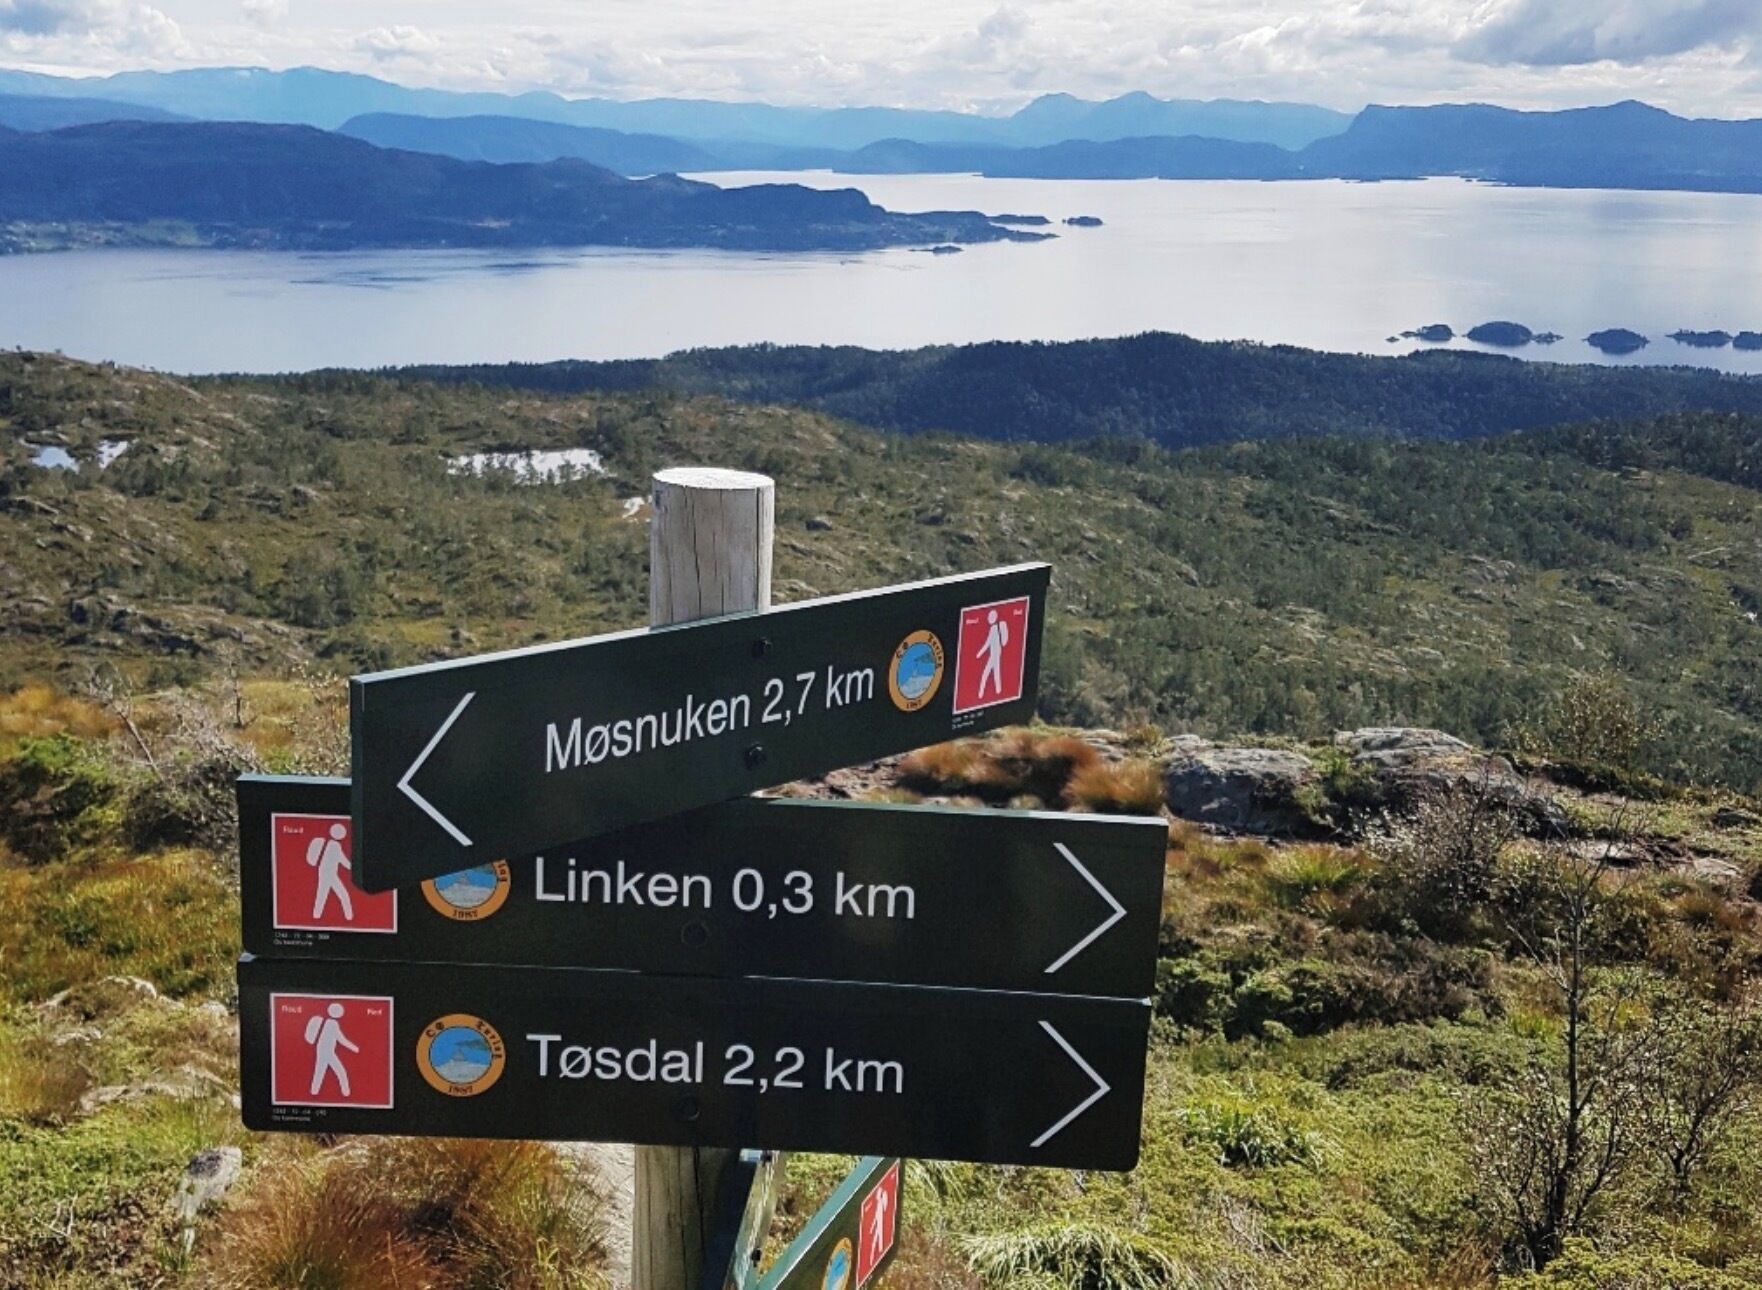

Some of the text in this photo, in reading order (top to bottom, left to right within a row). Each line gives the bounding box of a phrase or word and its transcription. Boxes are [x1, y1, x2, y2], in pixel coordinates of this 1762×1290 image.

[545, 665, 875, 772] Møsnuken 2,7 km
[535, 857, 915, 920] Linken 0,3 km
[526, 1034, 905, 1094] Tøsdal 2,2 km
